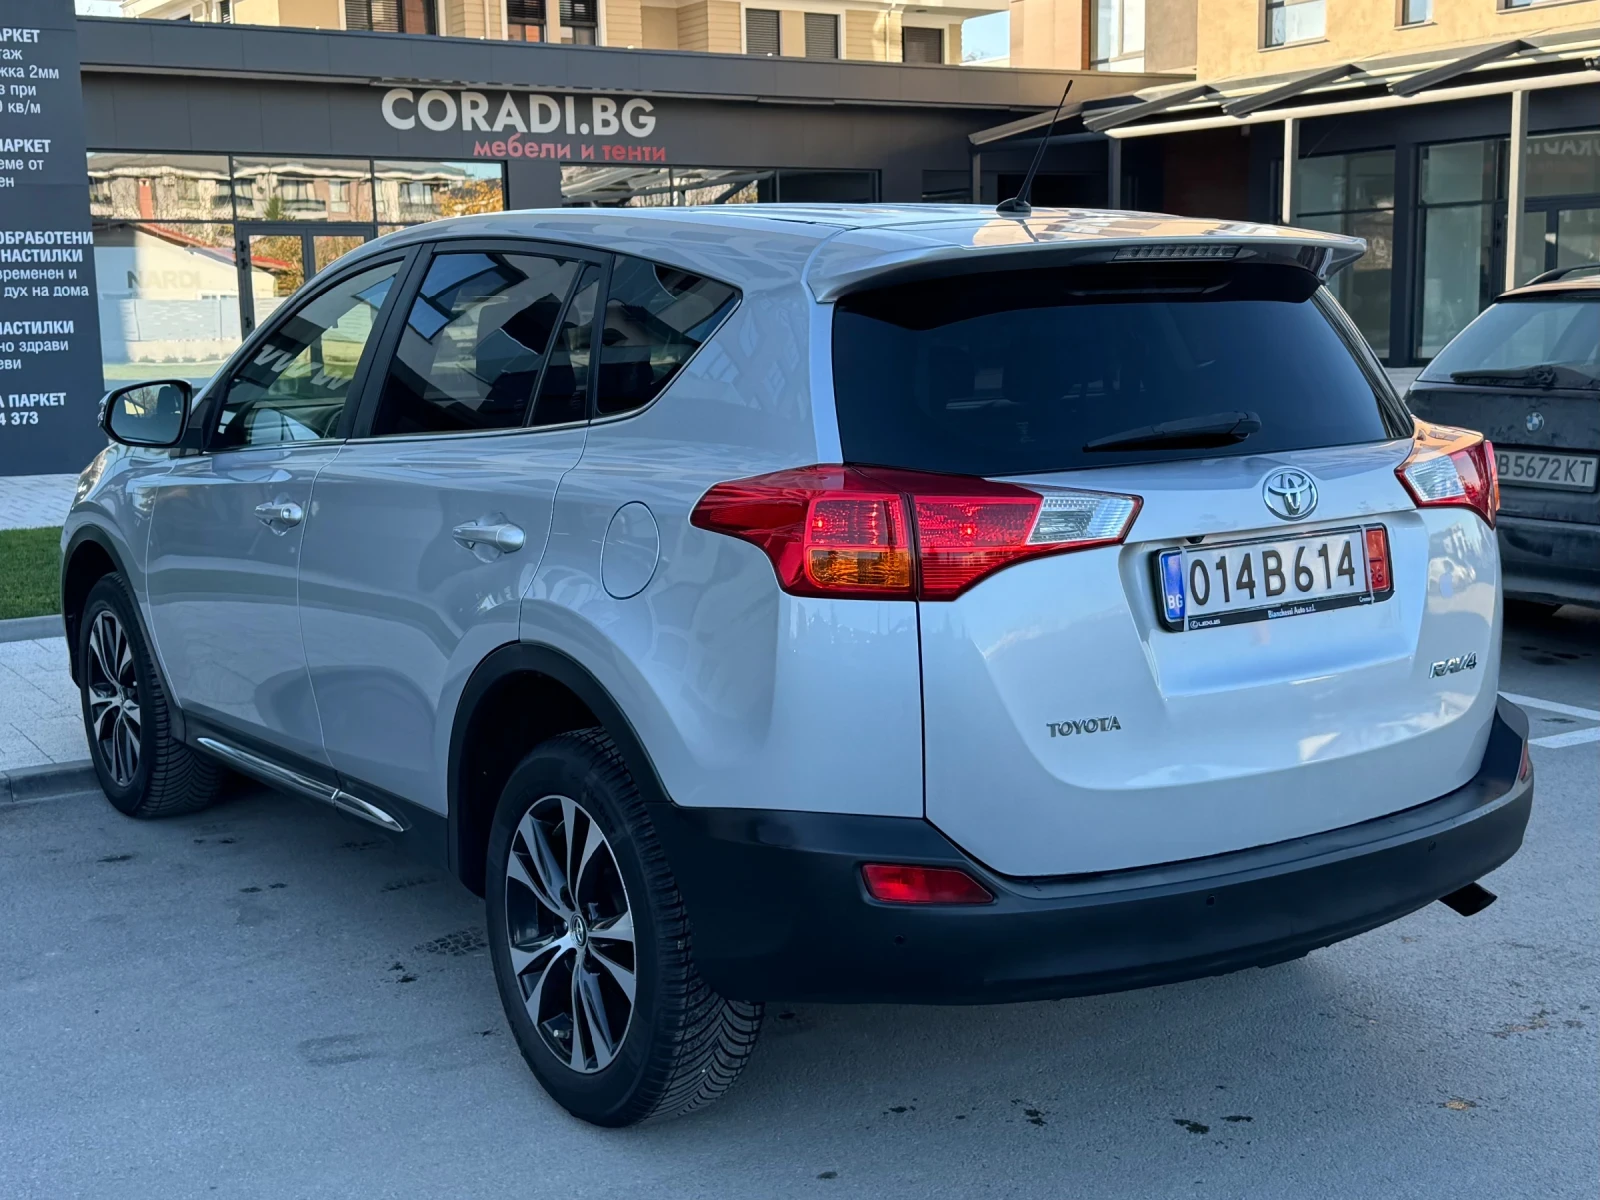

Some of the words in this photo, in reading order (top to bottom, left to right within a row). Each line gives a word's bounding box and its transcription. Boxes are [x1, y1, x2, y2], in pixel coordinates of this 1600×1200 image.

[0, 28, 41, 43] РКЕТ
[29, 64, 59, 79] 2мм
[10, 84, 37, 98] при
[8, 100, 41, 115] кв/м
[381, 88, 657, 138] CORADI.BG
[473, 132, 571, 159] мебели
[581, 144, 595, 160] и
[601, 144, 667, 162] тенти
[28, 159, 45, 171] от
[0, 249, 84, 263] НАСТИЛКИ
[0, 268, 64, 283] ременен
[68, 268, 78, 280] и
[4, 286, 28, 299] дух
[32, 286, 49, 297] на
[53, 285, 89, 298] дома
[0, 320, 75, 335] АСТИЛКИ
[18, 340, 69, 355] здрави
[8, 392, 67, 408] ПАРКЕТ
[10, 411, 39, 426] 373
[1496, 454, 1593, 484] B5672KT
[1167, 593, 1184, 610] BG
[1189, 540, 1356, 606] 014B614
[1429, 651, 1477, 679] RAV4
[1045, 715, 1122, 738] TOYOTA
